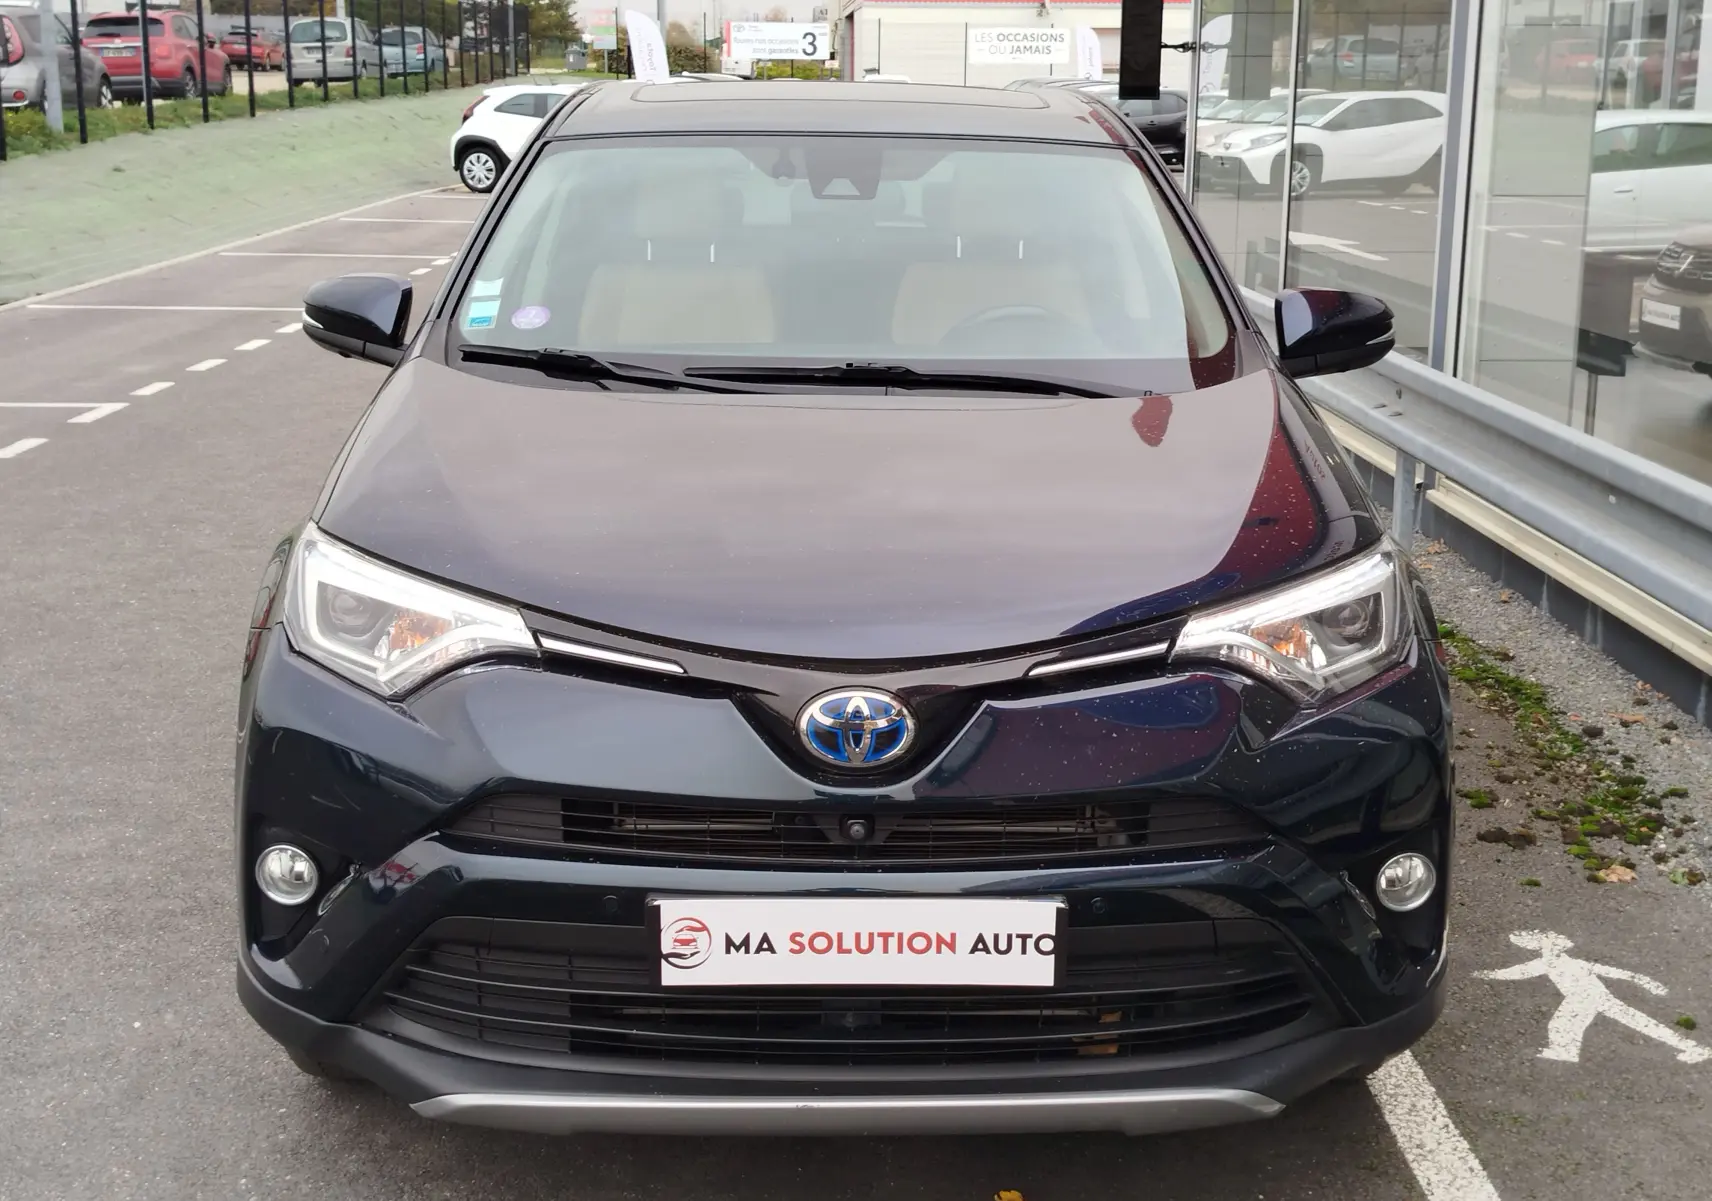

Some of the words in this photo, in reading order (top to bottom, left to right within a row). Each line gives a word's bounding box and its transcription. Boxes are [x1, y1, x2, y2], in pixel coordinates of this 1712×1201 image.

[802, 31, 818, 57] 3
[974, 32, 993, 43] LES
[996, 32, 1065, 43] OCCASIONS
[988, 44, 1007, 55] OU
[1009, 44, 1052, 55] JAMAIS
[724, 932, 777, 955] MA
[788, 931, 957, 955] SOLUTION
[968, 932, 1056, 956] AUTO
